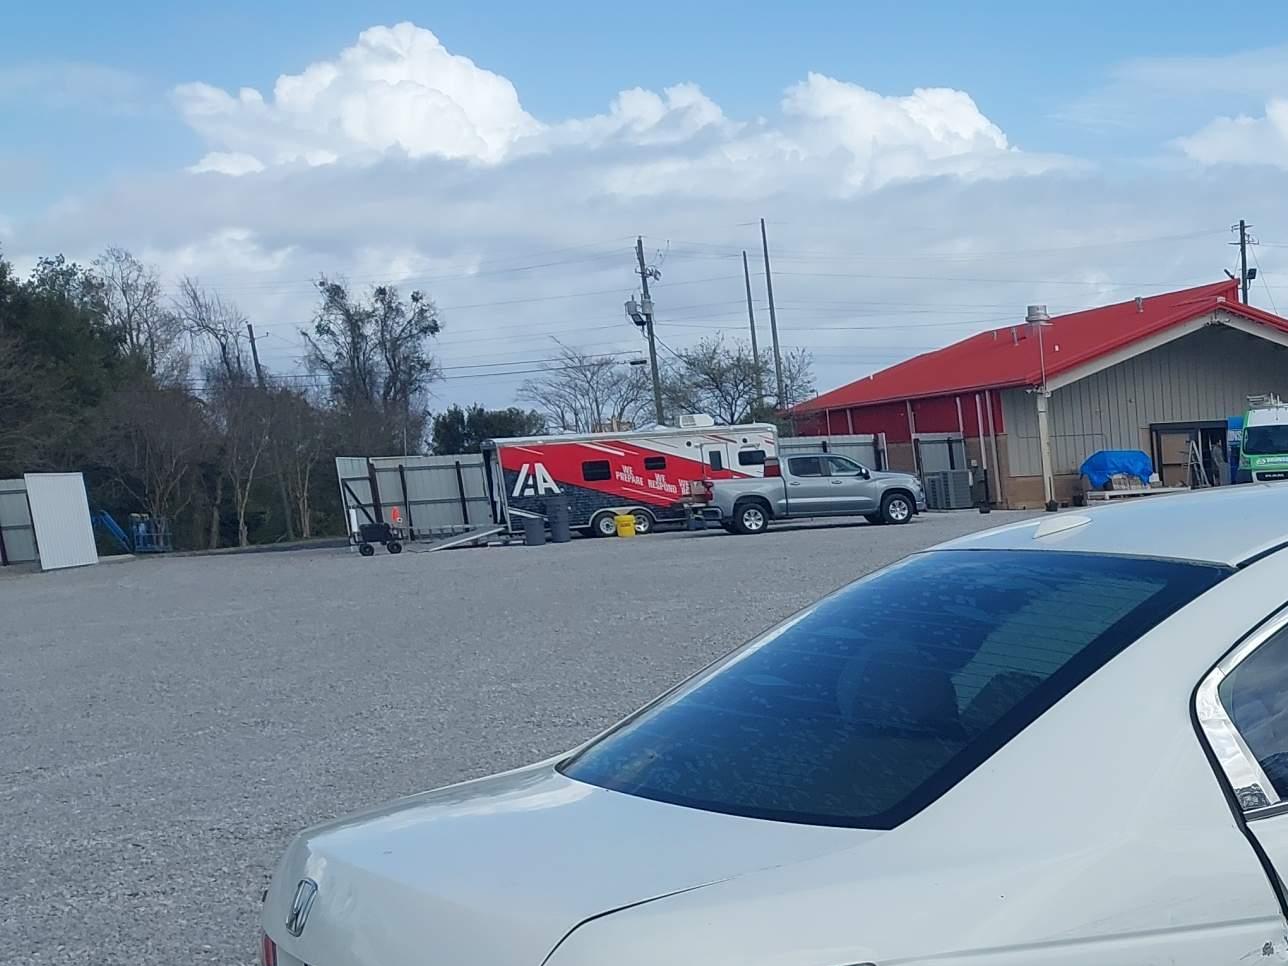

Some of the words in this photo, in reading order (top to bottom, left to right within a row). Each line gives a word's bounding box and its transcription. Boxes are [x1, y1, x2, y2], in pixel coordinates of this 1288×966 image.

[622, 465, 633, 474] WE
[615, 471, 644, 486] PREPARE
[655, 473, 665, 482] WE
[647, 479, 678, 494] RESPOND
